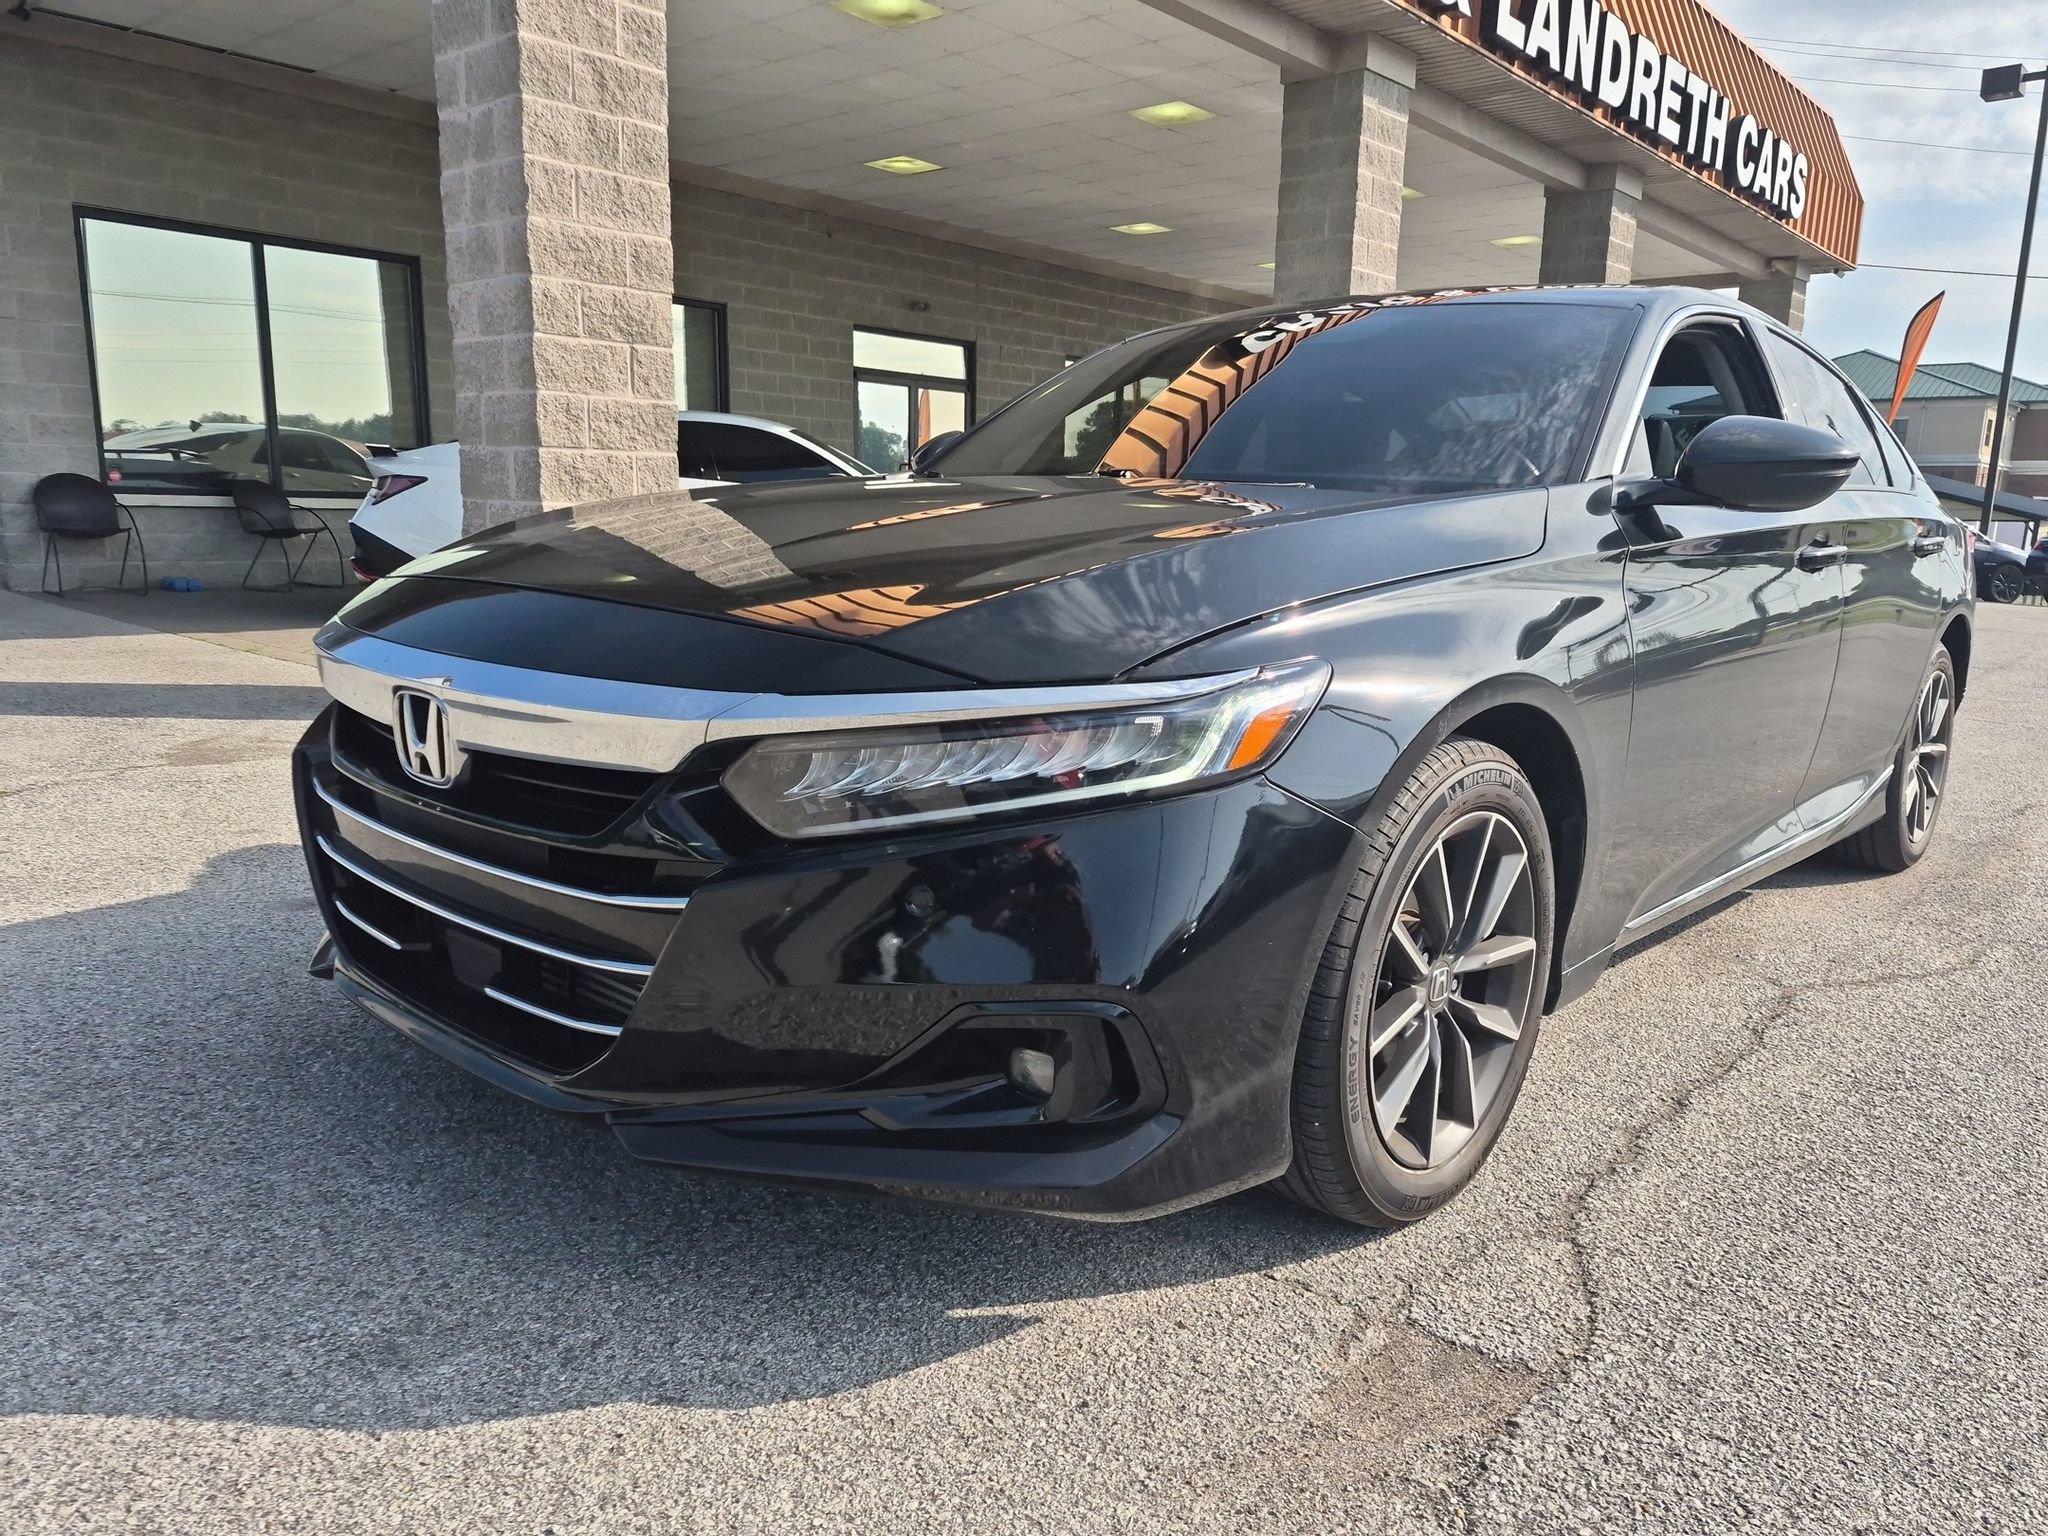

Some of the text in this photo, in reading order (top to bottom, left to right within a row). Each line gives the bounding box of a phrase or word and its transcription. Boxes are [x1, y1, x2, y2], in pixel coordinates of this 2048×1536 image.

[1736, 114, 1809, 219] CARS
[1463, 769, 1512, 791] MICHELIN
[1348, 1035, 1360, 1124] ENERGY
